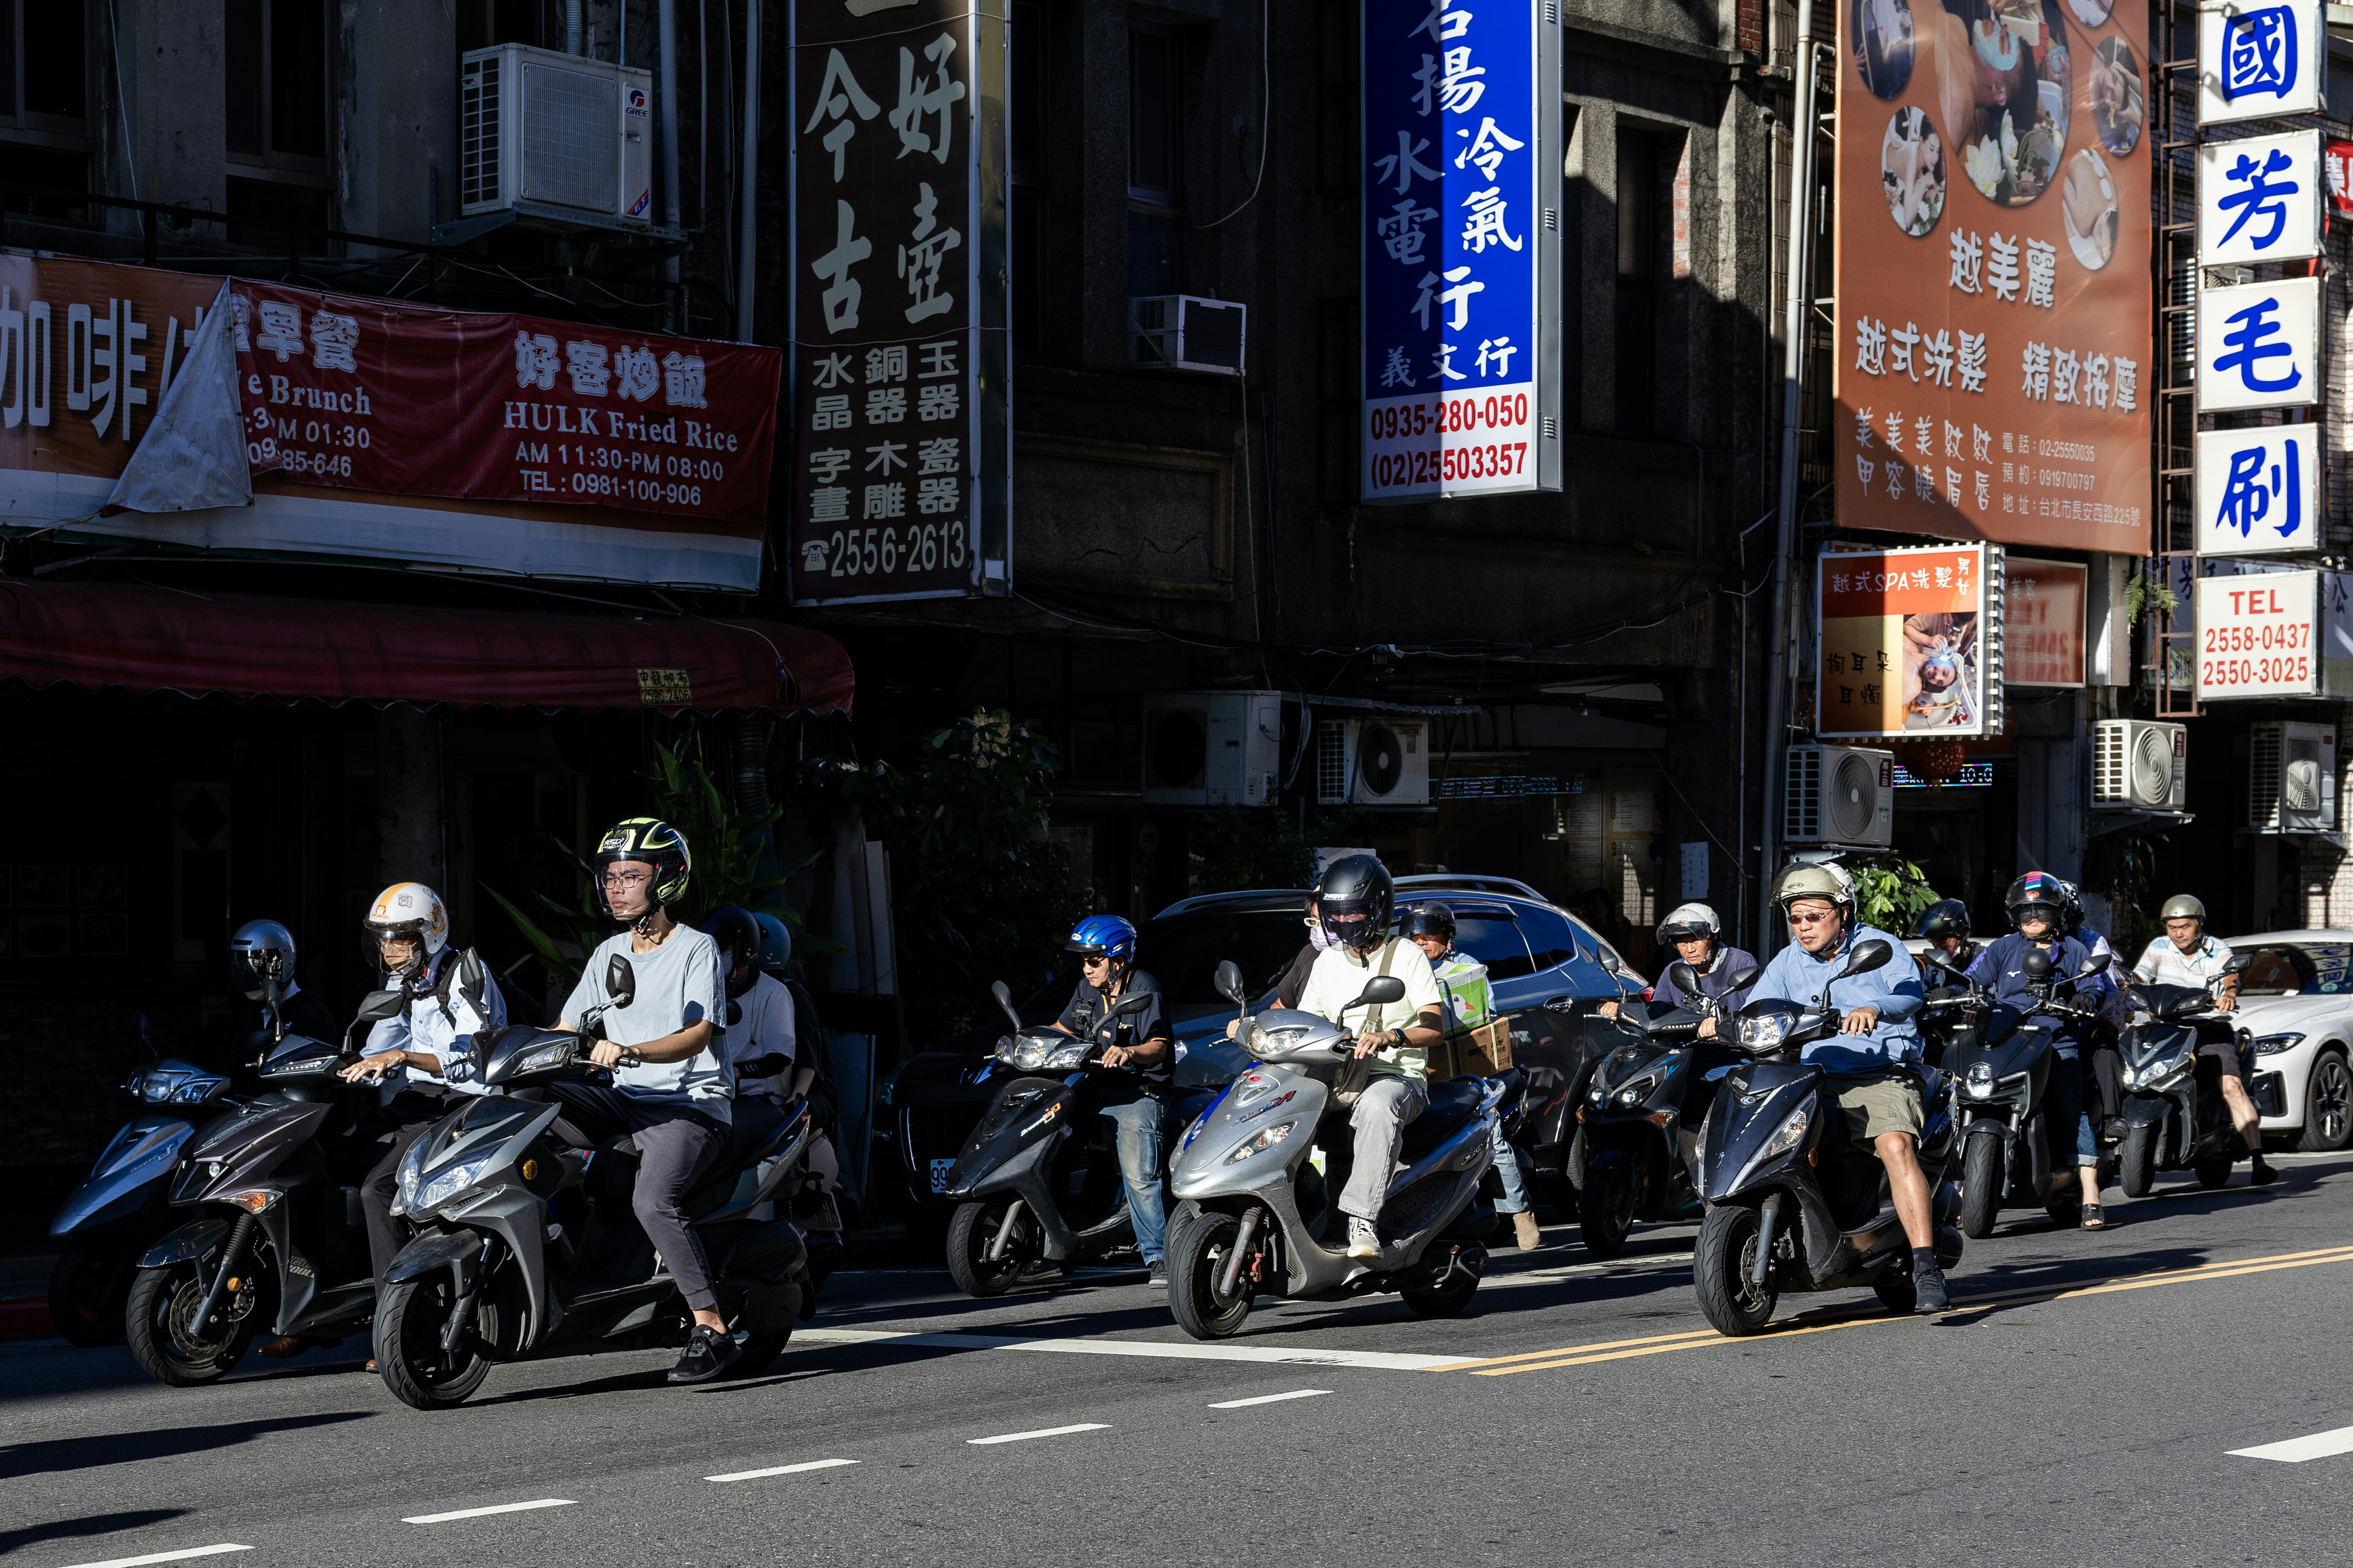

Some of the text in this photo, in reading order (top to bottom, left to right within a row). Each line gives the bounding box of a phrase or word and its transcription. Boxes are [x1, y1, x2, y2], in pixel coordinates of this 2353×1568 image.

[626, 107, 648, 118] GREE
[804, 48, 881, 335] 今古
[1373, 131, 1446, 265] 水電
[1454, 116, 1525, 253] 冷氣
[1949, 227, 2056, 308] 越美麗
[2213, 5, 2302, 538] 國芳毛刷
[1410, 266, 1485, 331] 行
[515, 330, 708, 409] 好客炒飯
[1855, 315, 1987, 393] 越式洗髮
[269, 374, 372, 415] Brunch
[1372, 393, 1527, 440] 0935-280-050
[306, 421, 370, 449] 01:30
[504, 401, 738, 453] HULK Fried Rice
[809, 352, 855, 523] 水晶 字畫
[863, 345, 907, 520] 銅器 木雕
[917, 340, 960, 514] 玉器 瓷器
[516, 442, 549, 464] AM
[667, 456, 724, 482] 08:00
[1372, 442, 1527, 489] (02)25503357
[2040, 469, 2095, 491] 0919700797
[572, 472, 701, 506] 0981-100-906
[831, 520, 965, 577] 2556-2613
[1832, 565, 1953, 593] 越式SPA洗髮
[1956, 556, 1971, 596] 男女
[2229, 589, 2284, 615] TEL
[2206, 623, 2310, 653] 2558-0437
[2203, 657, 2307, 686] 2550-3025
[931, 1167, 953, 1188] 99
